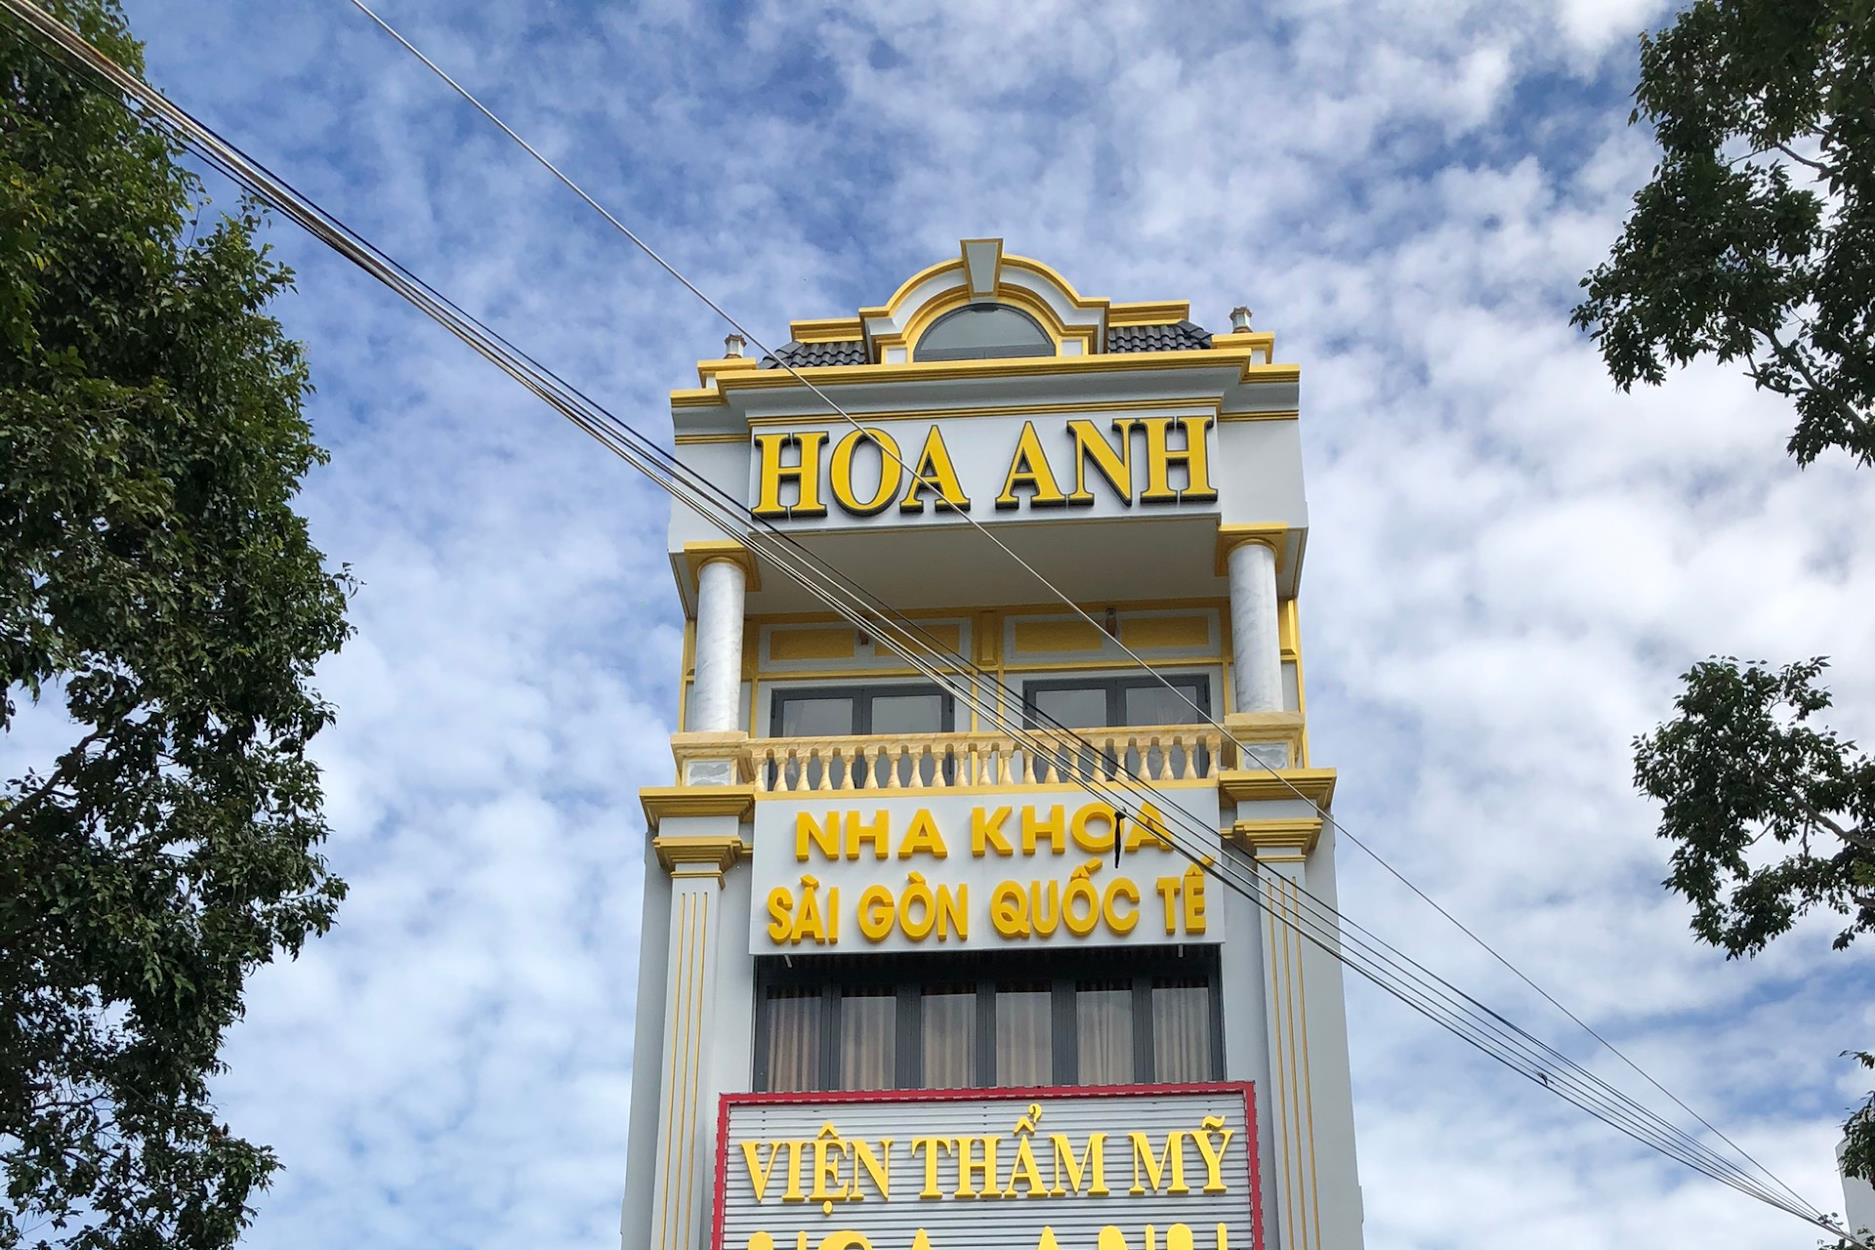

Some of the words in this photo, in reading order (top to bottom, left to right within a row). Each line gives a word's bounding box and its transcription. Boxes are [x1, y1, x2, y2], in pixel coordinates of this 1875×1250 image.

[751, 425, 971, 520] HOA
[995, 416, 1219, 509] ANH
[796, 809, 949, 861] NHA
[970, 801, 1175, 859] KHOA
[767, 874, 841, 945] SÀI
[857, 870, 969, 943] GÒN
[990, 857, 1140, 937] QUỐC
[1156, 856, 1216, 935] TẾ
[739, 1120, 894, 1217] VIỆN
[911, 1102, 1111, 1200] THẨM
[1127, 1115, 1235, 1196] MỸ
